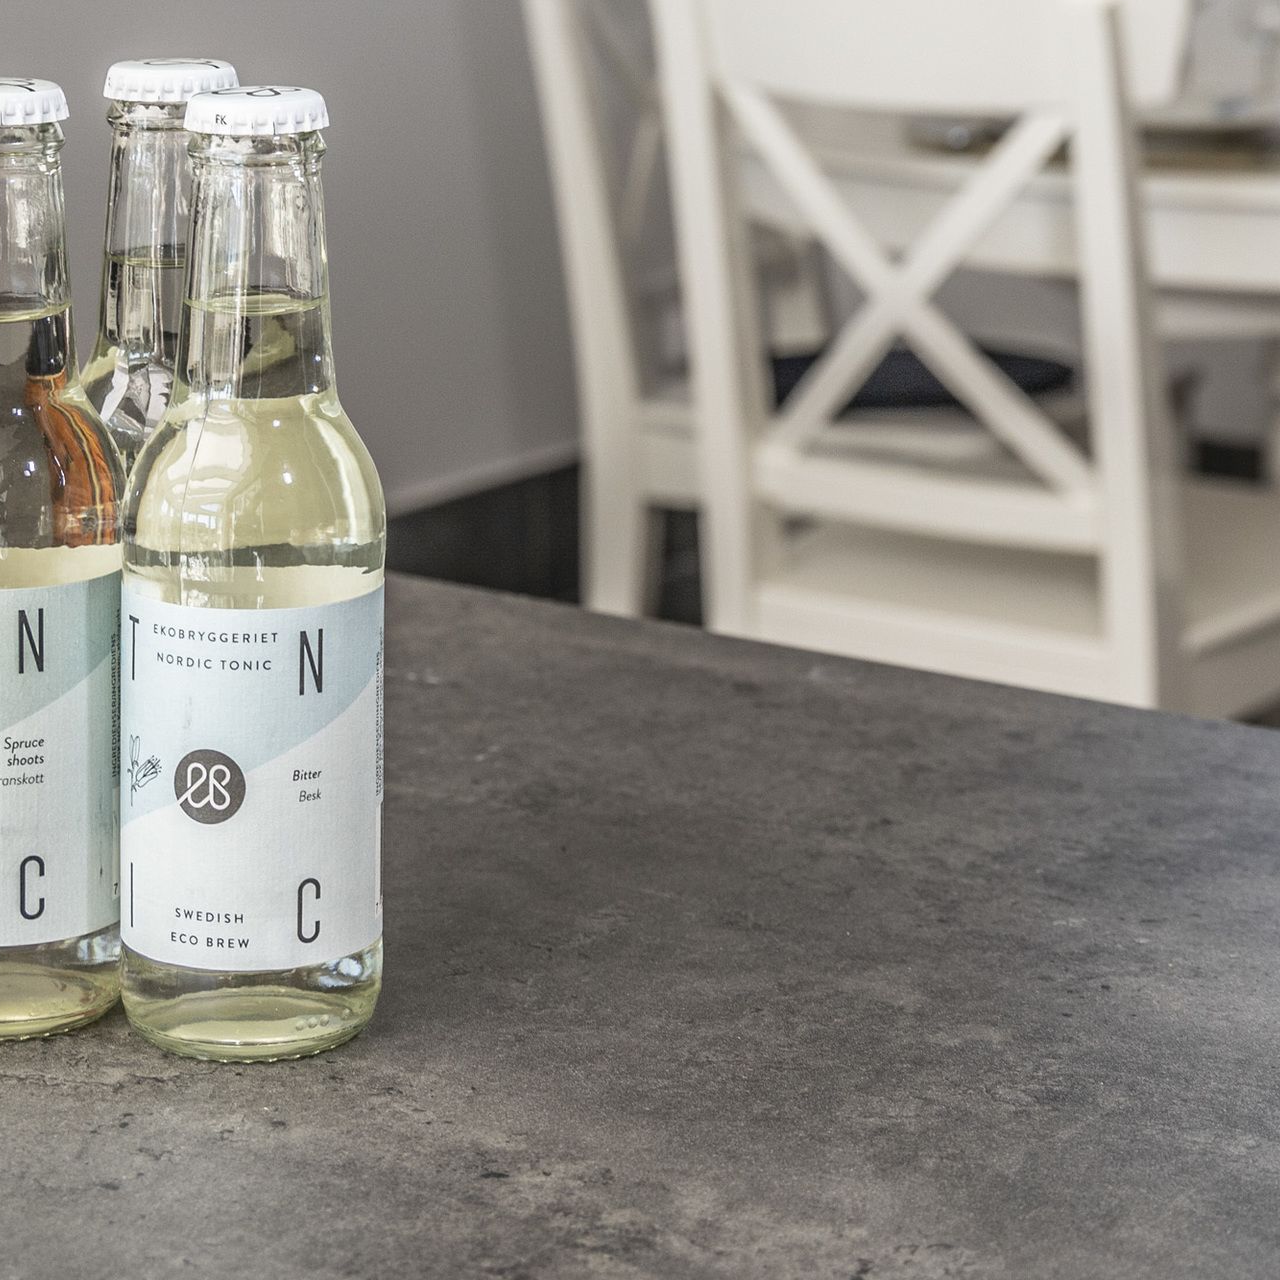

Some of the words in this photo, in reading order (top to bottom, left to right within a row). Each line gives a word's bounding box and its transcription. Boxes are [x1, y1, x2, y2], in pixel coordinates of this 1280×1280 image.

[18, 608, 44, 675] N
[153, 623, 278, 644] EKOBRYGGERIET
[129, 614, 140, 681] T
[156, 652, 212, 670] NORDIC
[220, 660, 272, 671] TONIC
[299, 628, 324, 696] N
[3, 736, 45, 754] Spruce
[7, 754, 45, 767] shoots
[292, 769, 322, 782] Bitter
[298, 788, 322, 802] Besk
[20, 855, 45, 920] C
[175, 907, 244, 924] SWEDISH
[297, 877, 321, 944] C
[170, 931, 199, 946] ECO
[206, 937, 250, 949] BREW
